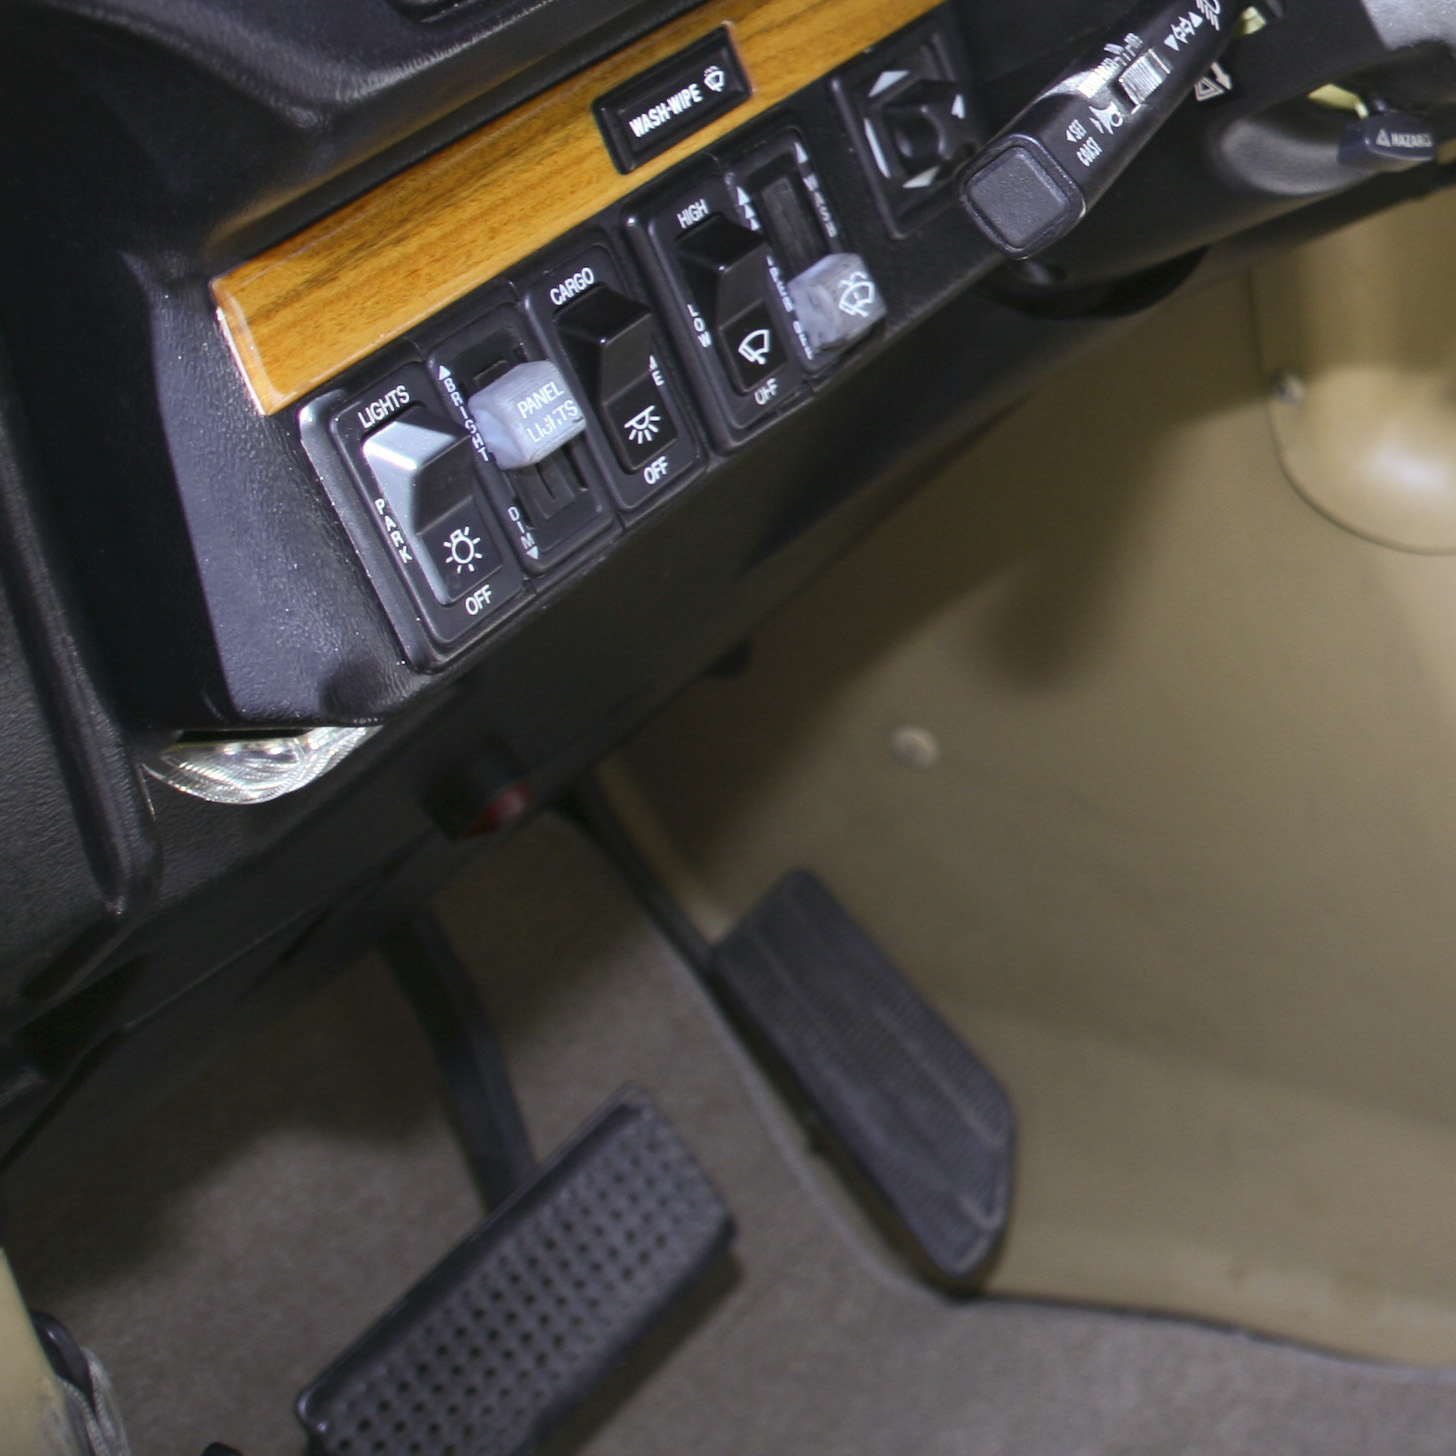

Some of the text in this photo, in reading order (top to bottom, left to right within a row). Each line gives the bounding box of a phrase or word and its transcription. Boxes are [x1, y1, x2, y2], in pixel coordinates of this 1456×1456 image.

[628, 83, 703, 138] WASH-WIPE
[677, 199, 709, 229] HIGH
[550, 267, 595, 306] CARGO
[687, 304, 713, 348] LOW
[358, 385, 410, 429] LIGHTS
[443, 378, 490, 462] BRIGHT
[517, 381, 565, 419] PANEL
[643, 455, 669, 485] OFF
[375, 498, 413, 564] PARK
[508, 506, 536, 550] DIM
[465, 584, 492, 616] OFF
